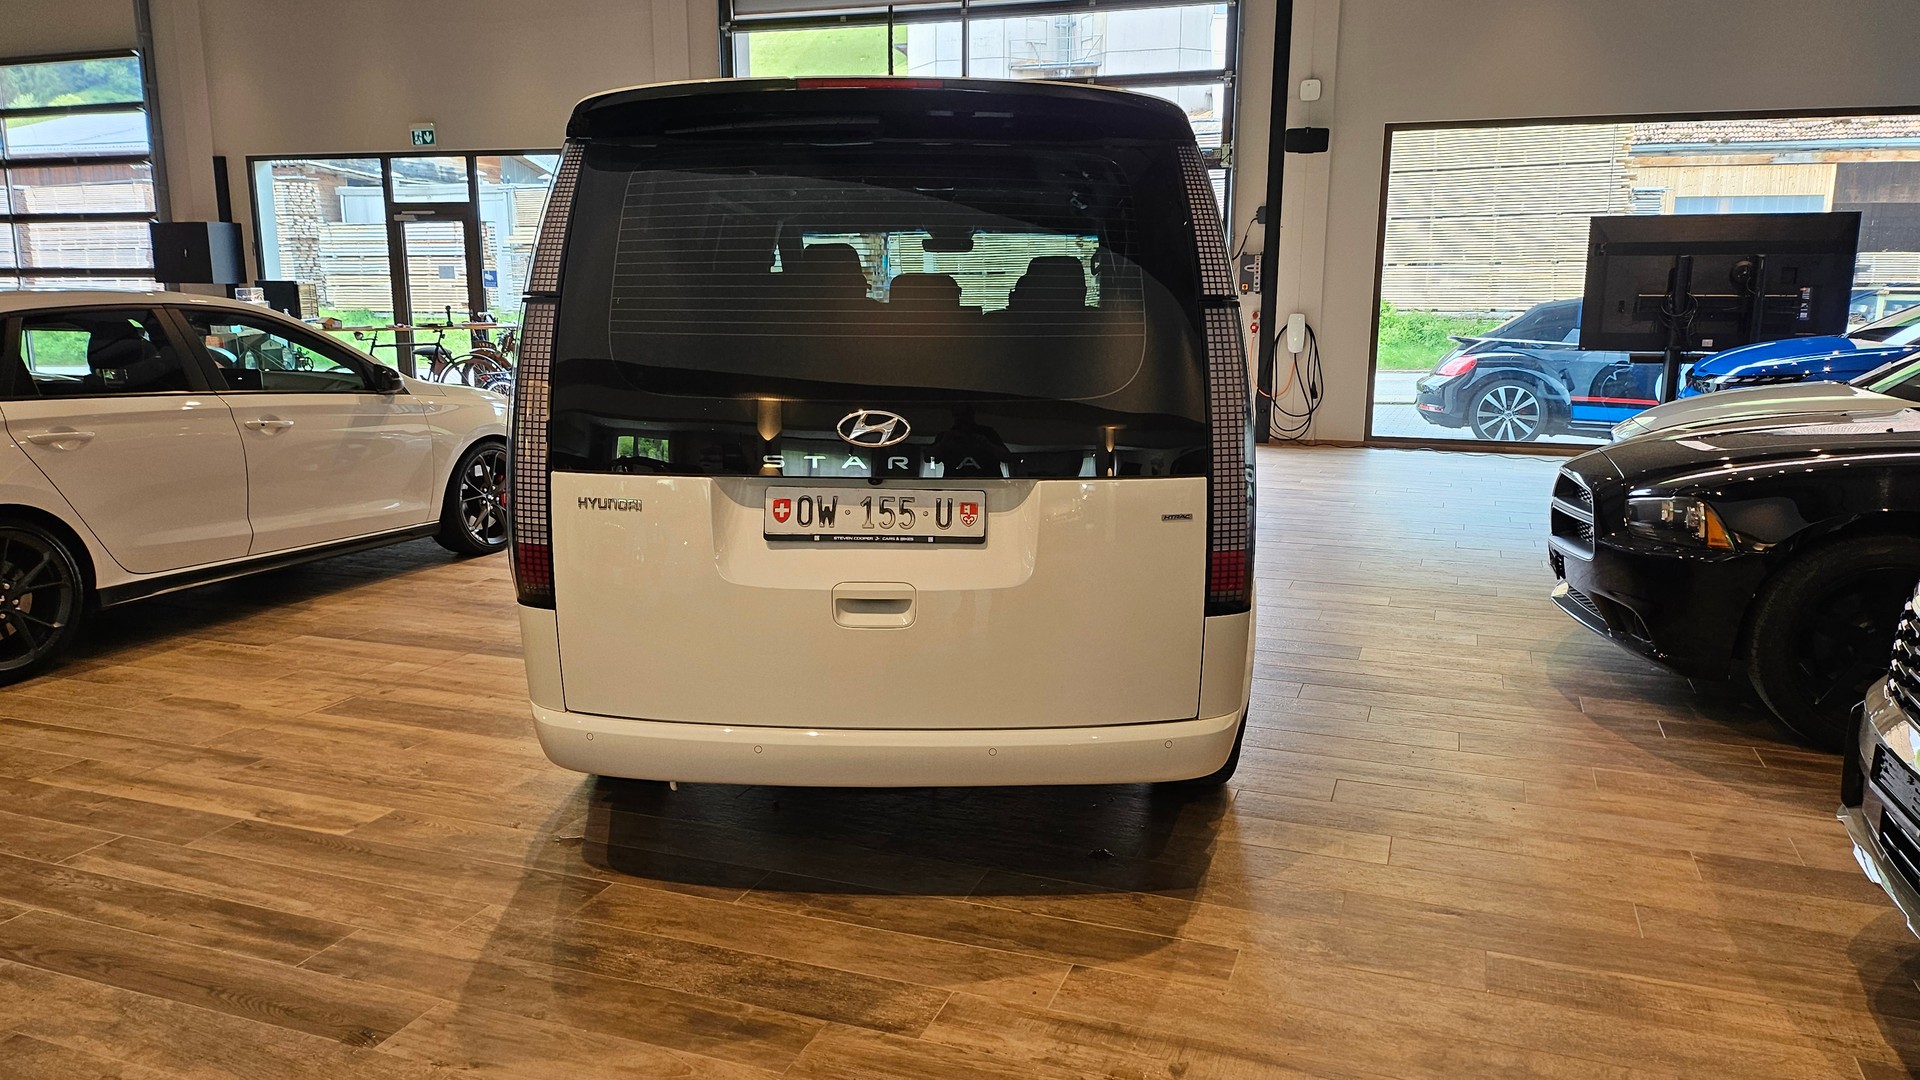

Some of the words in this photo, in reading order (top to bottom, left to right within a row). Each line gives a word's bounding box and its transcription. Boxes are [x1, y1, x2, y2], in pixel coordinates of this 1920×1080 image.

[763, 455, 981, 470] STARIA
[577, 496, 643, 512] HYUNDAI
[796, 494, 838, 528] OW
[860, 495, 916, 530] 155
[935, 497, 954, 530] U
